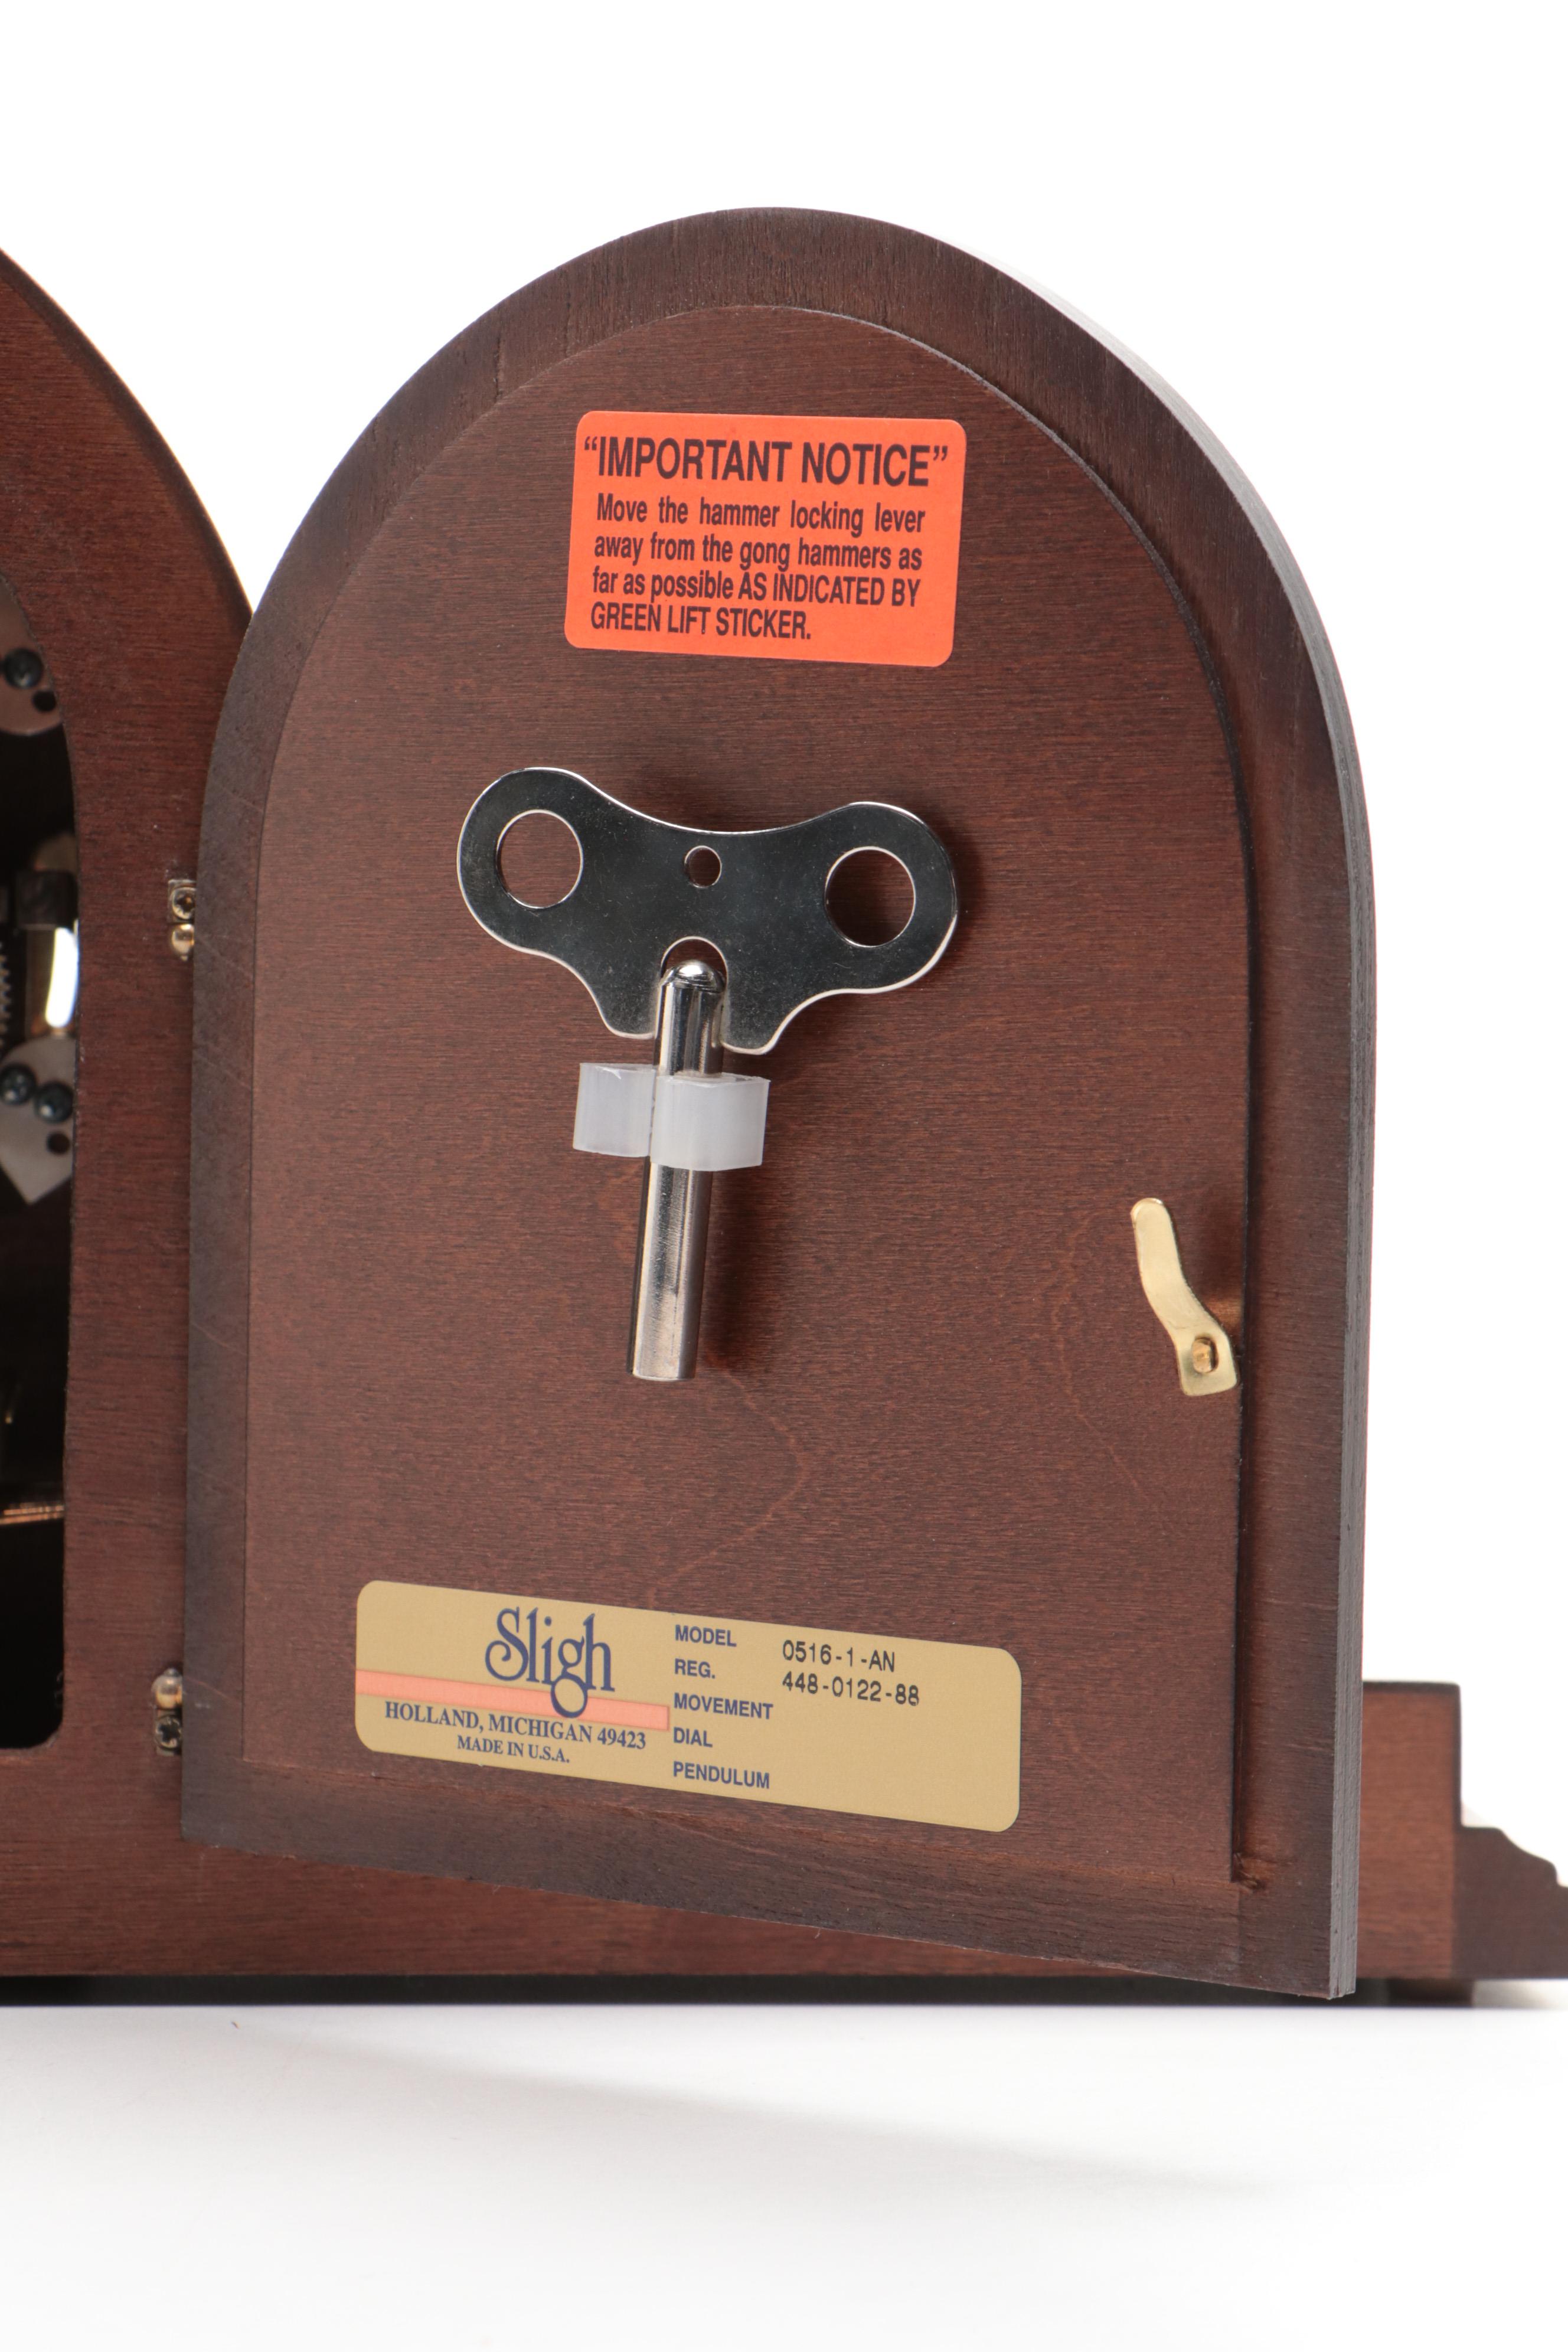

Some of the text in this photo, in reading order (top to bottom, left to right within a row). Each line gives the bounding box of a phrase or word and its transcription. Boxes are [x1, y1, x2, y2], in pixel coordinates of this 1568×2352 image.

[585, 437, 948, 486] “IMPORTANT NOTICE”
[597, 493, 925, 538] Move the hammer locking lever
[594, 532, 922, 572] away from the gong hammers as
[593, 566, 920, 606] far as possible AS INDICATED BY
[592, 602, 810, 639] GREEN LIFT STICKER.
[485, 1607, 615, 1719] Sligh
[675, 1625, 894, 1672] MODEL 0516-1-AN
[675, 1658, 919, 1706] REG. 448-0122-88
[386, 1701, 646, 1749] HOLLAND, MICHIGAN 49423
[674, 1693, 773, 1719] MOVEMENT
[458, 1735, 570, 1763] MADE IN U.S.A.
[674, 1727, 713, 1747] DIAL
[674, 1761, 769, 1789] PENDULUM
